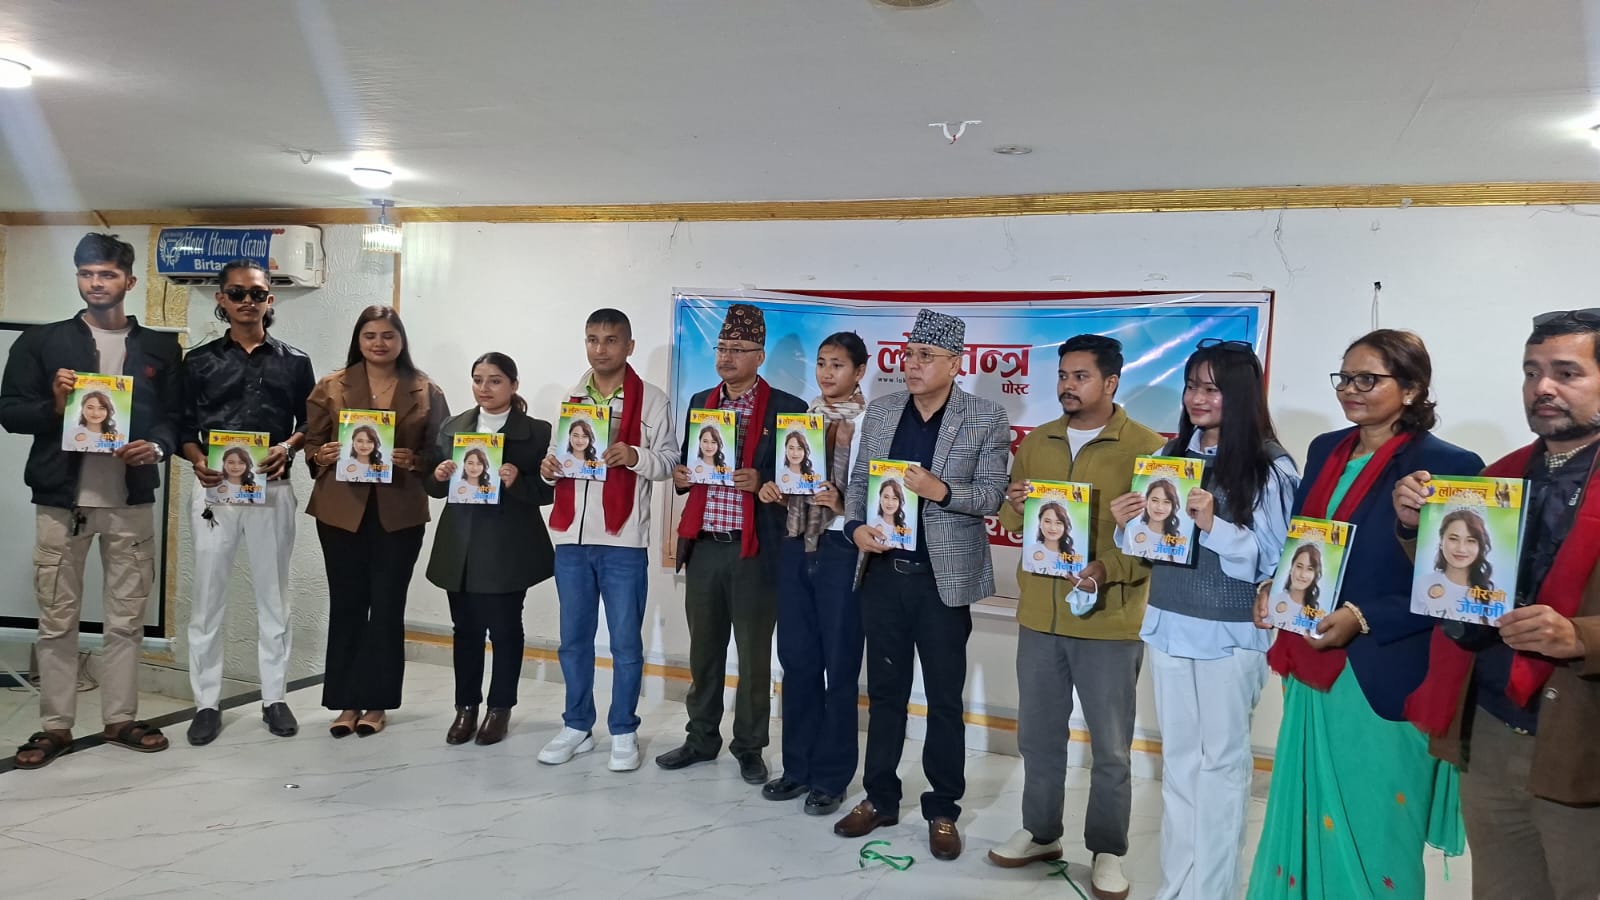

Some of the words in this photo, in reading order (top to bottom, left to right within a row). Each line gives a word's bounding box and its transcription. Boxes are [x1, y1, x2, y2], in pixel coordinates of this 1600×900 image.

[208, 232, 237, 256] Heaven
[241, 232, 268, 258] Grand
[1002, 381, 1031, 396] पोस्ट
